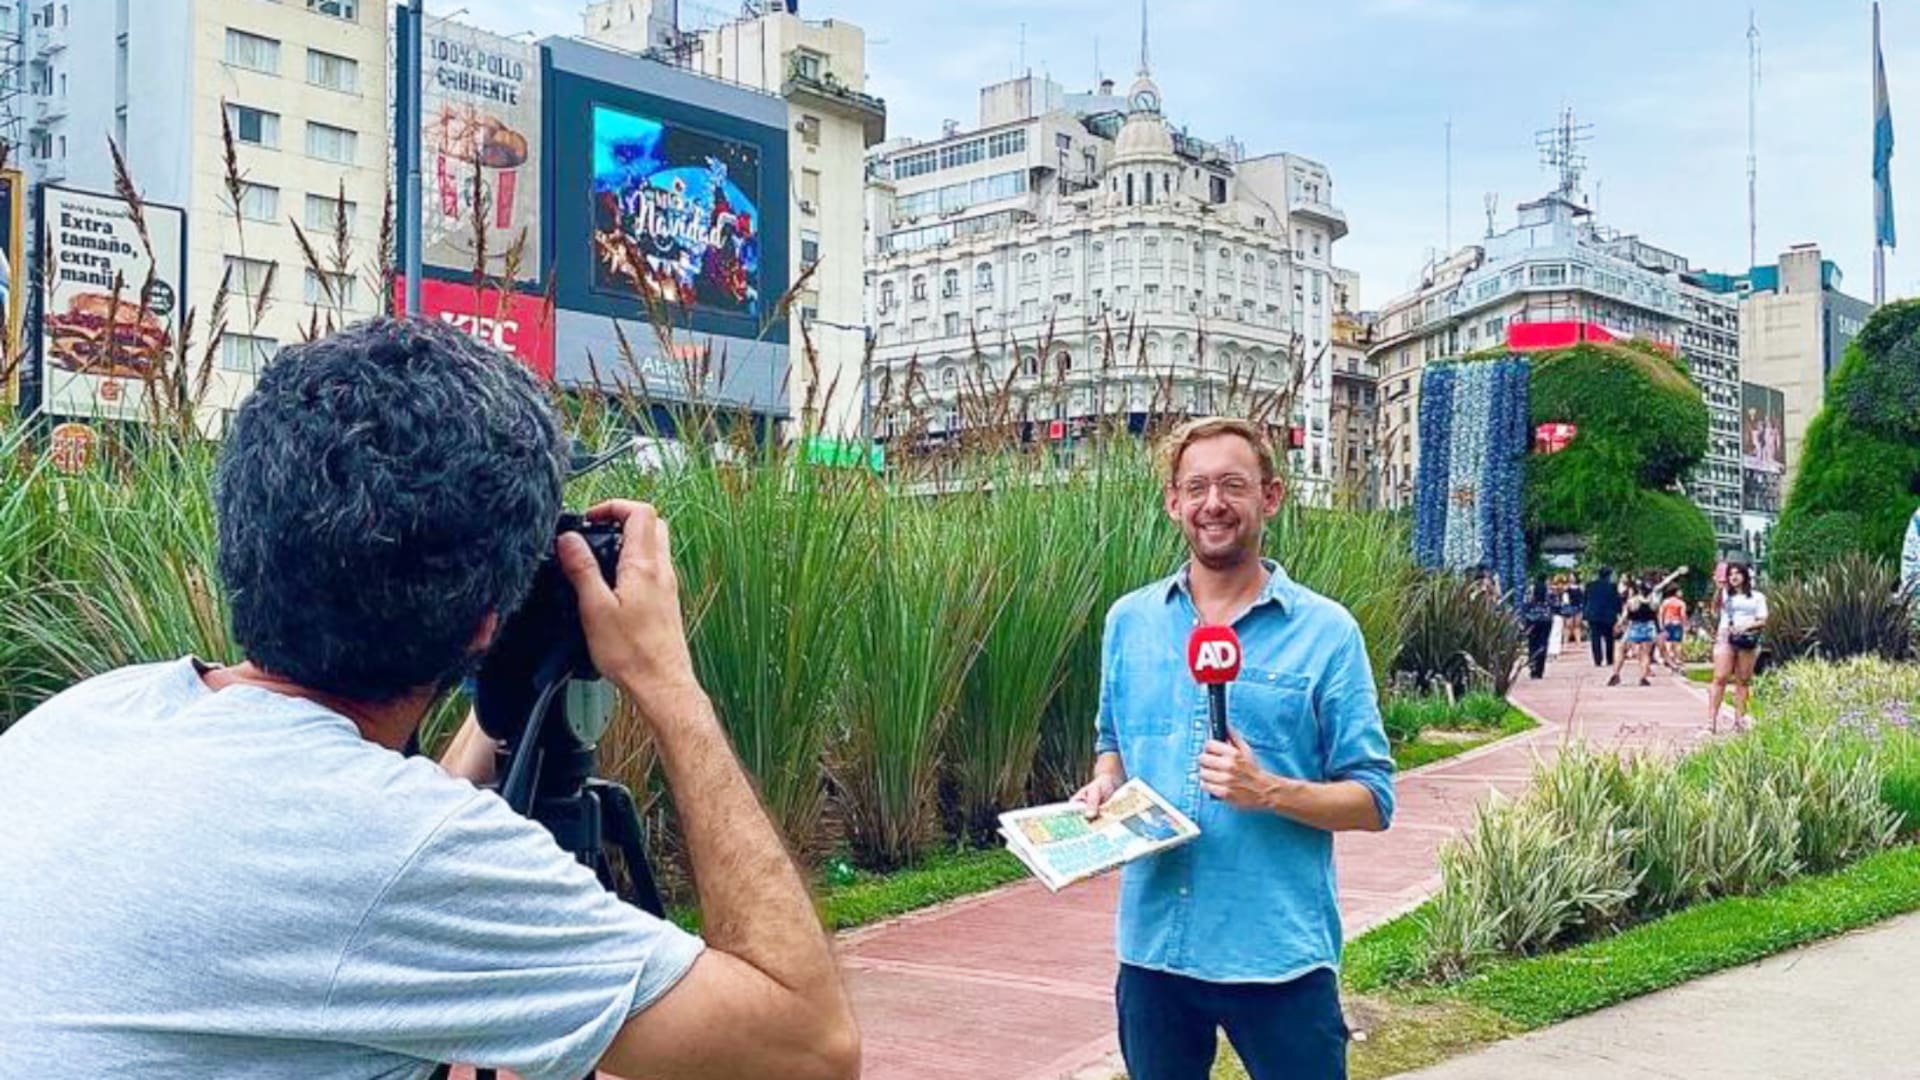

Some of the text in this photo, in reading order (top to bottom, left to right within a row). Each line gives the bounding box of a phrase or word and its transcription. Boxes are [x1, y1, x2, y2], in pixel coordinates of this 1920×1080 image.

[431, 39, 524, 82] 100% POLLO
[61, 212, 113, 234] Extra
[61, 231, 138, 259] tamaño,
[61, 250, 111, 269] extra
[61, 268, 131, 290] manij.
[1195, 641, 1237, 671] AD
